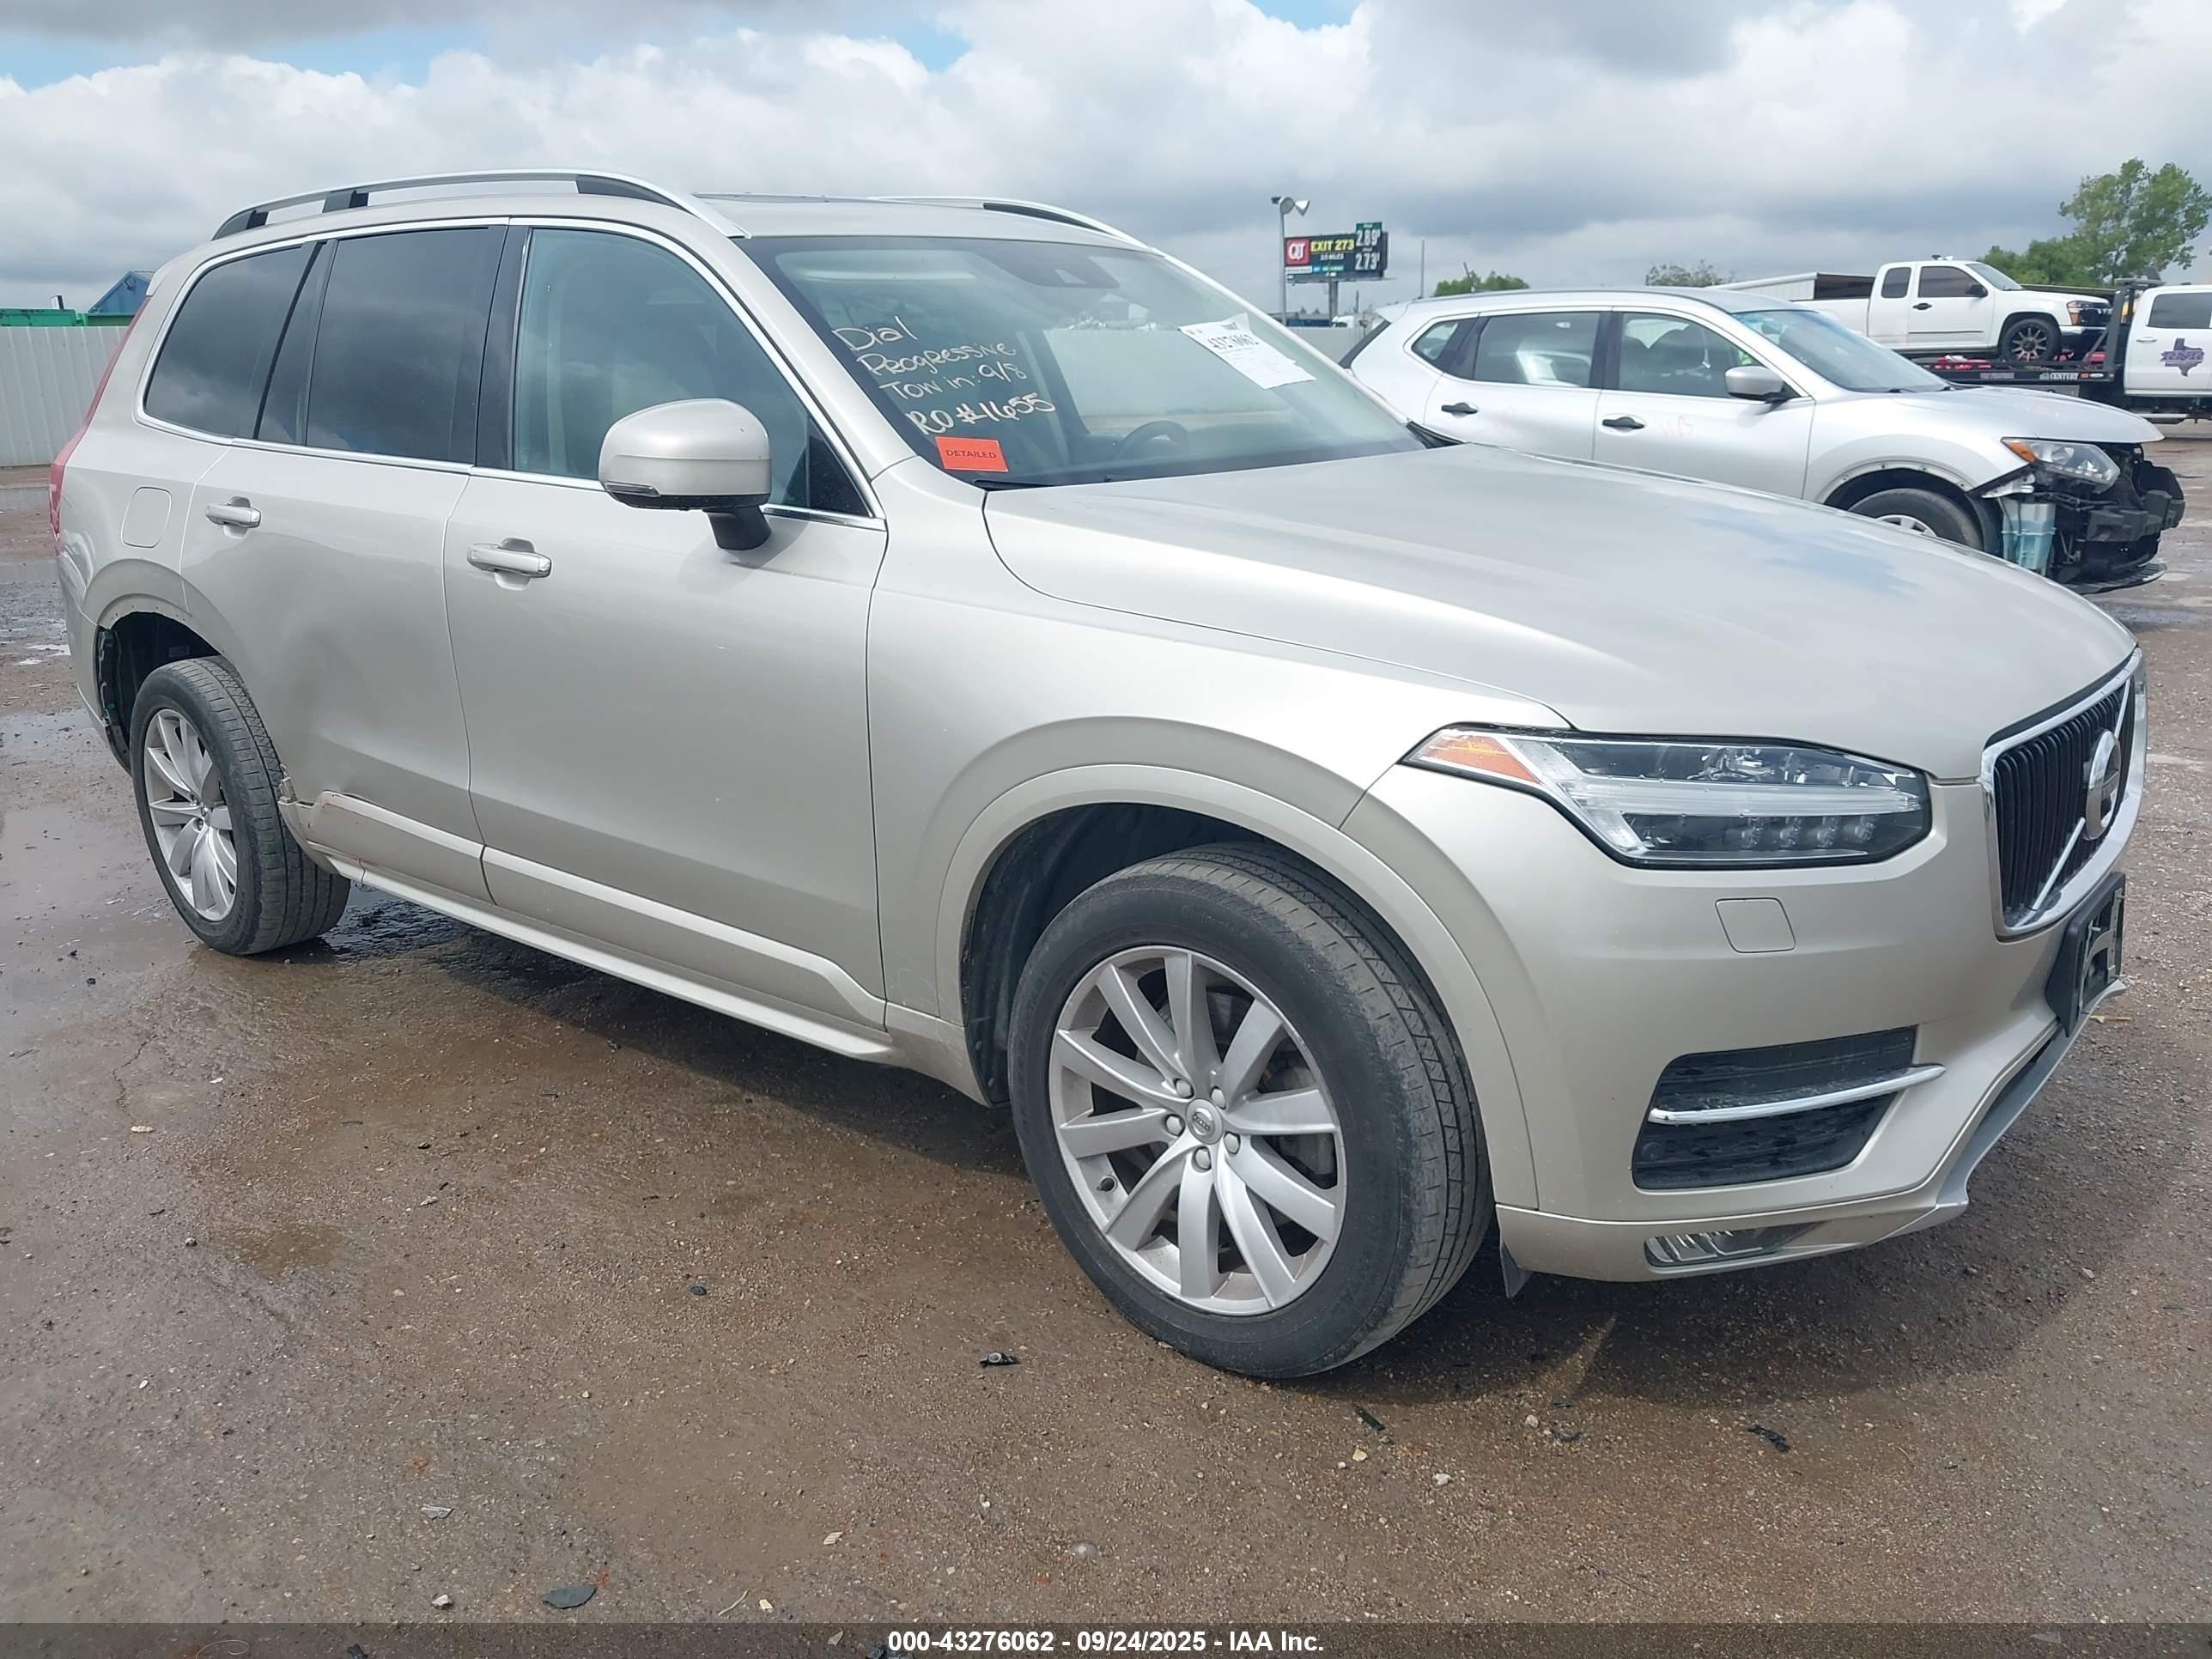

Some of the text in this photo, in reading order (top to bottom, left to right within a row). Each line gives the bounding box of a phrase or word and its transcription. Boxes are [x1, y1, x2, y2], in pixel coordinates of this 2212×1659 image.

[1288, 242, 1306, 261] QT
[1310, 239, 1355, 252] EXIT 273
[832, 315, 918, 351] Dial
[978, 362, 1027, 383] 9/8
[2050, 372, 2080, 380] CENTURY
[946, 449, 997, 459] DETAILED
